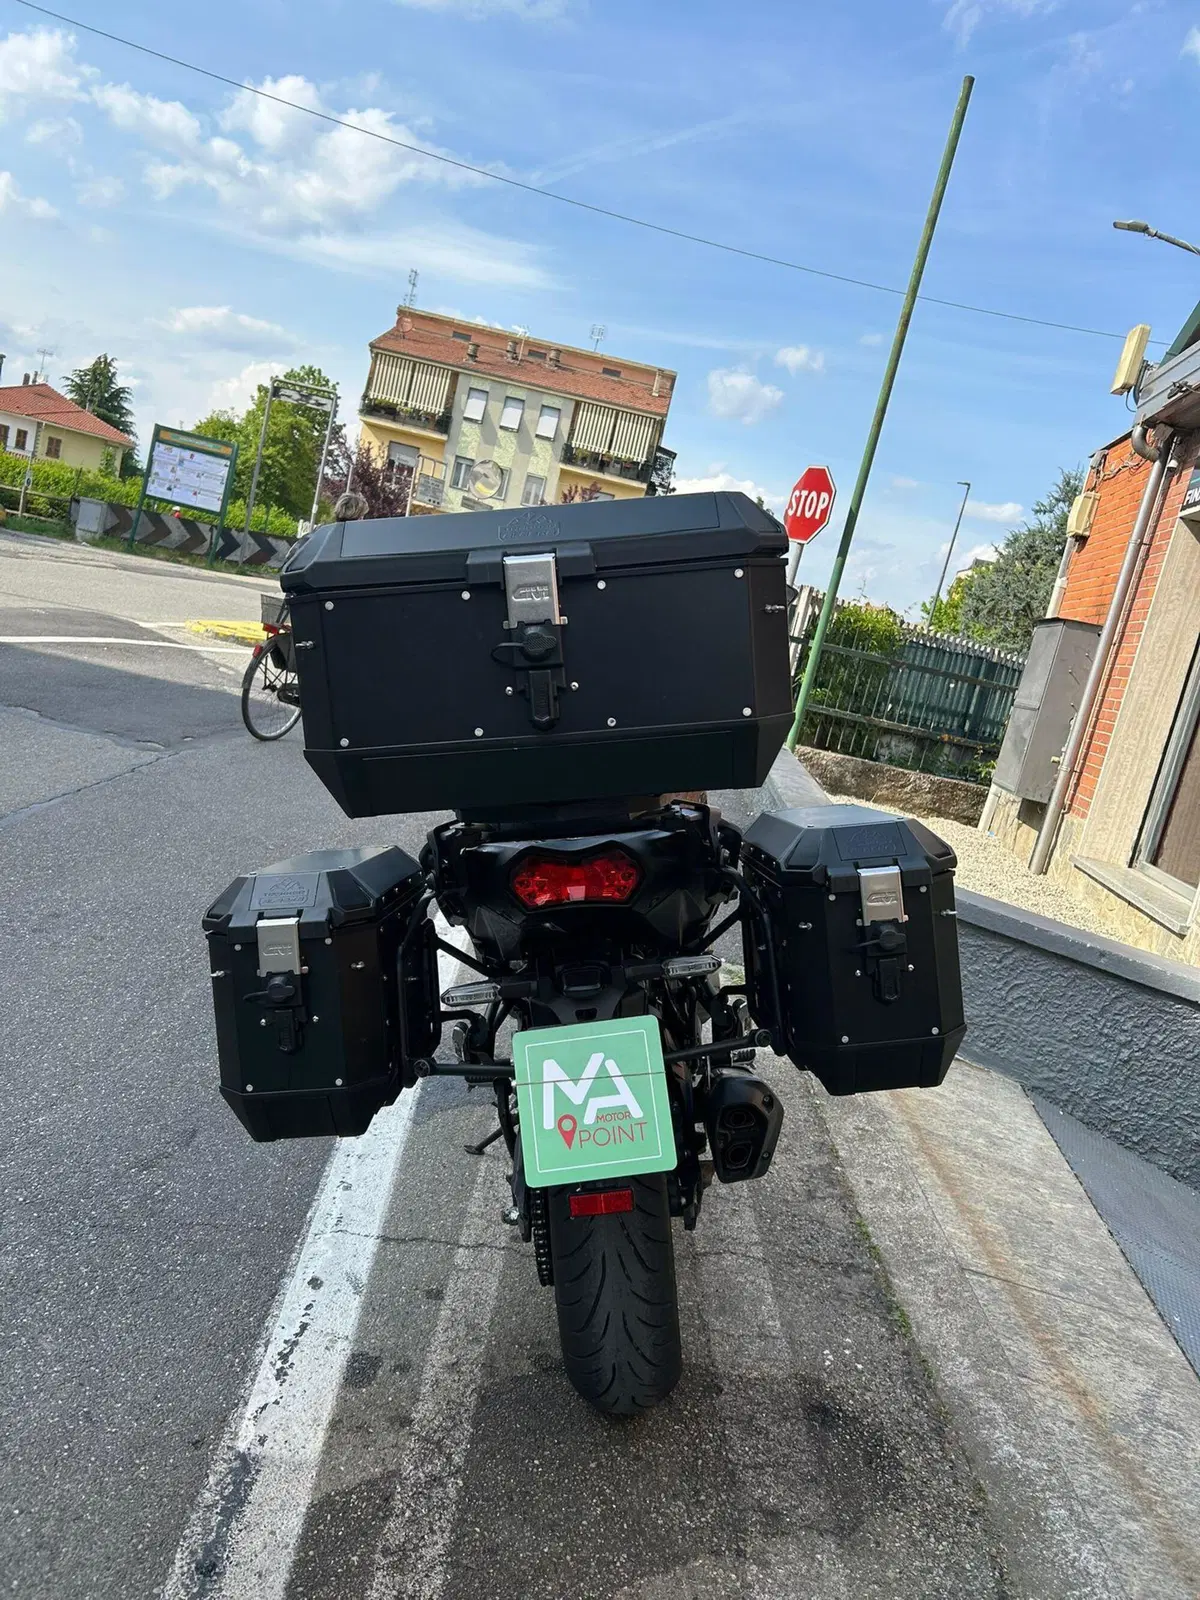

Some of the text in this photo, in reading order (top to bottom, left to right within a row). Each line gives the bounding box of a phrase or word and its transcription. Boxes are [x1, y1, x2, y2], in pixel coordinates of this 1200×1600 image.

[787, 489, 830, 520] STOP
[542, 1052, 644, 1131] MA
[595, 1111, 631, 1123] MOTOR
[577, 1121, 648, 1149] POINT
